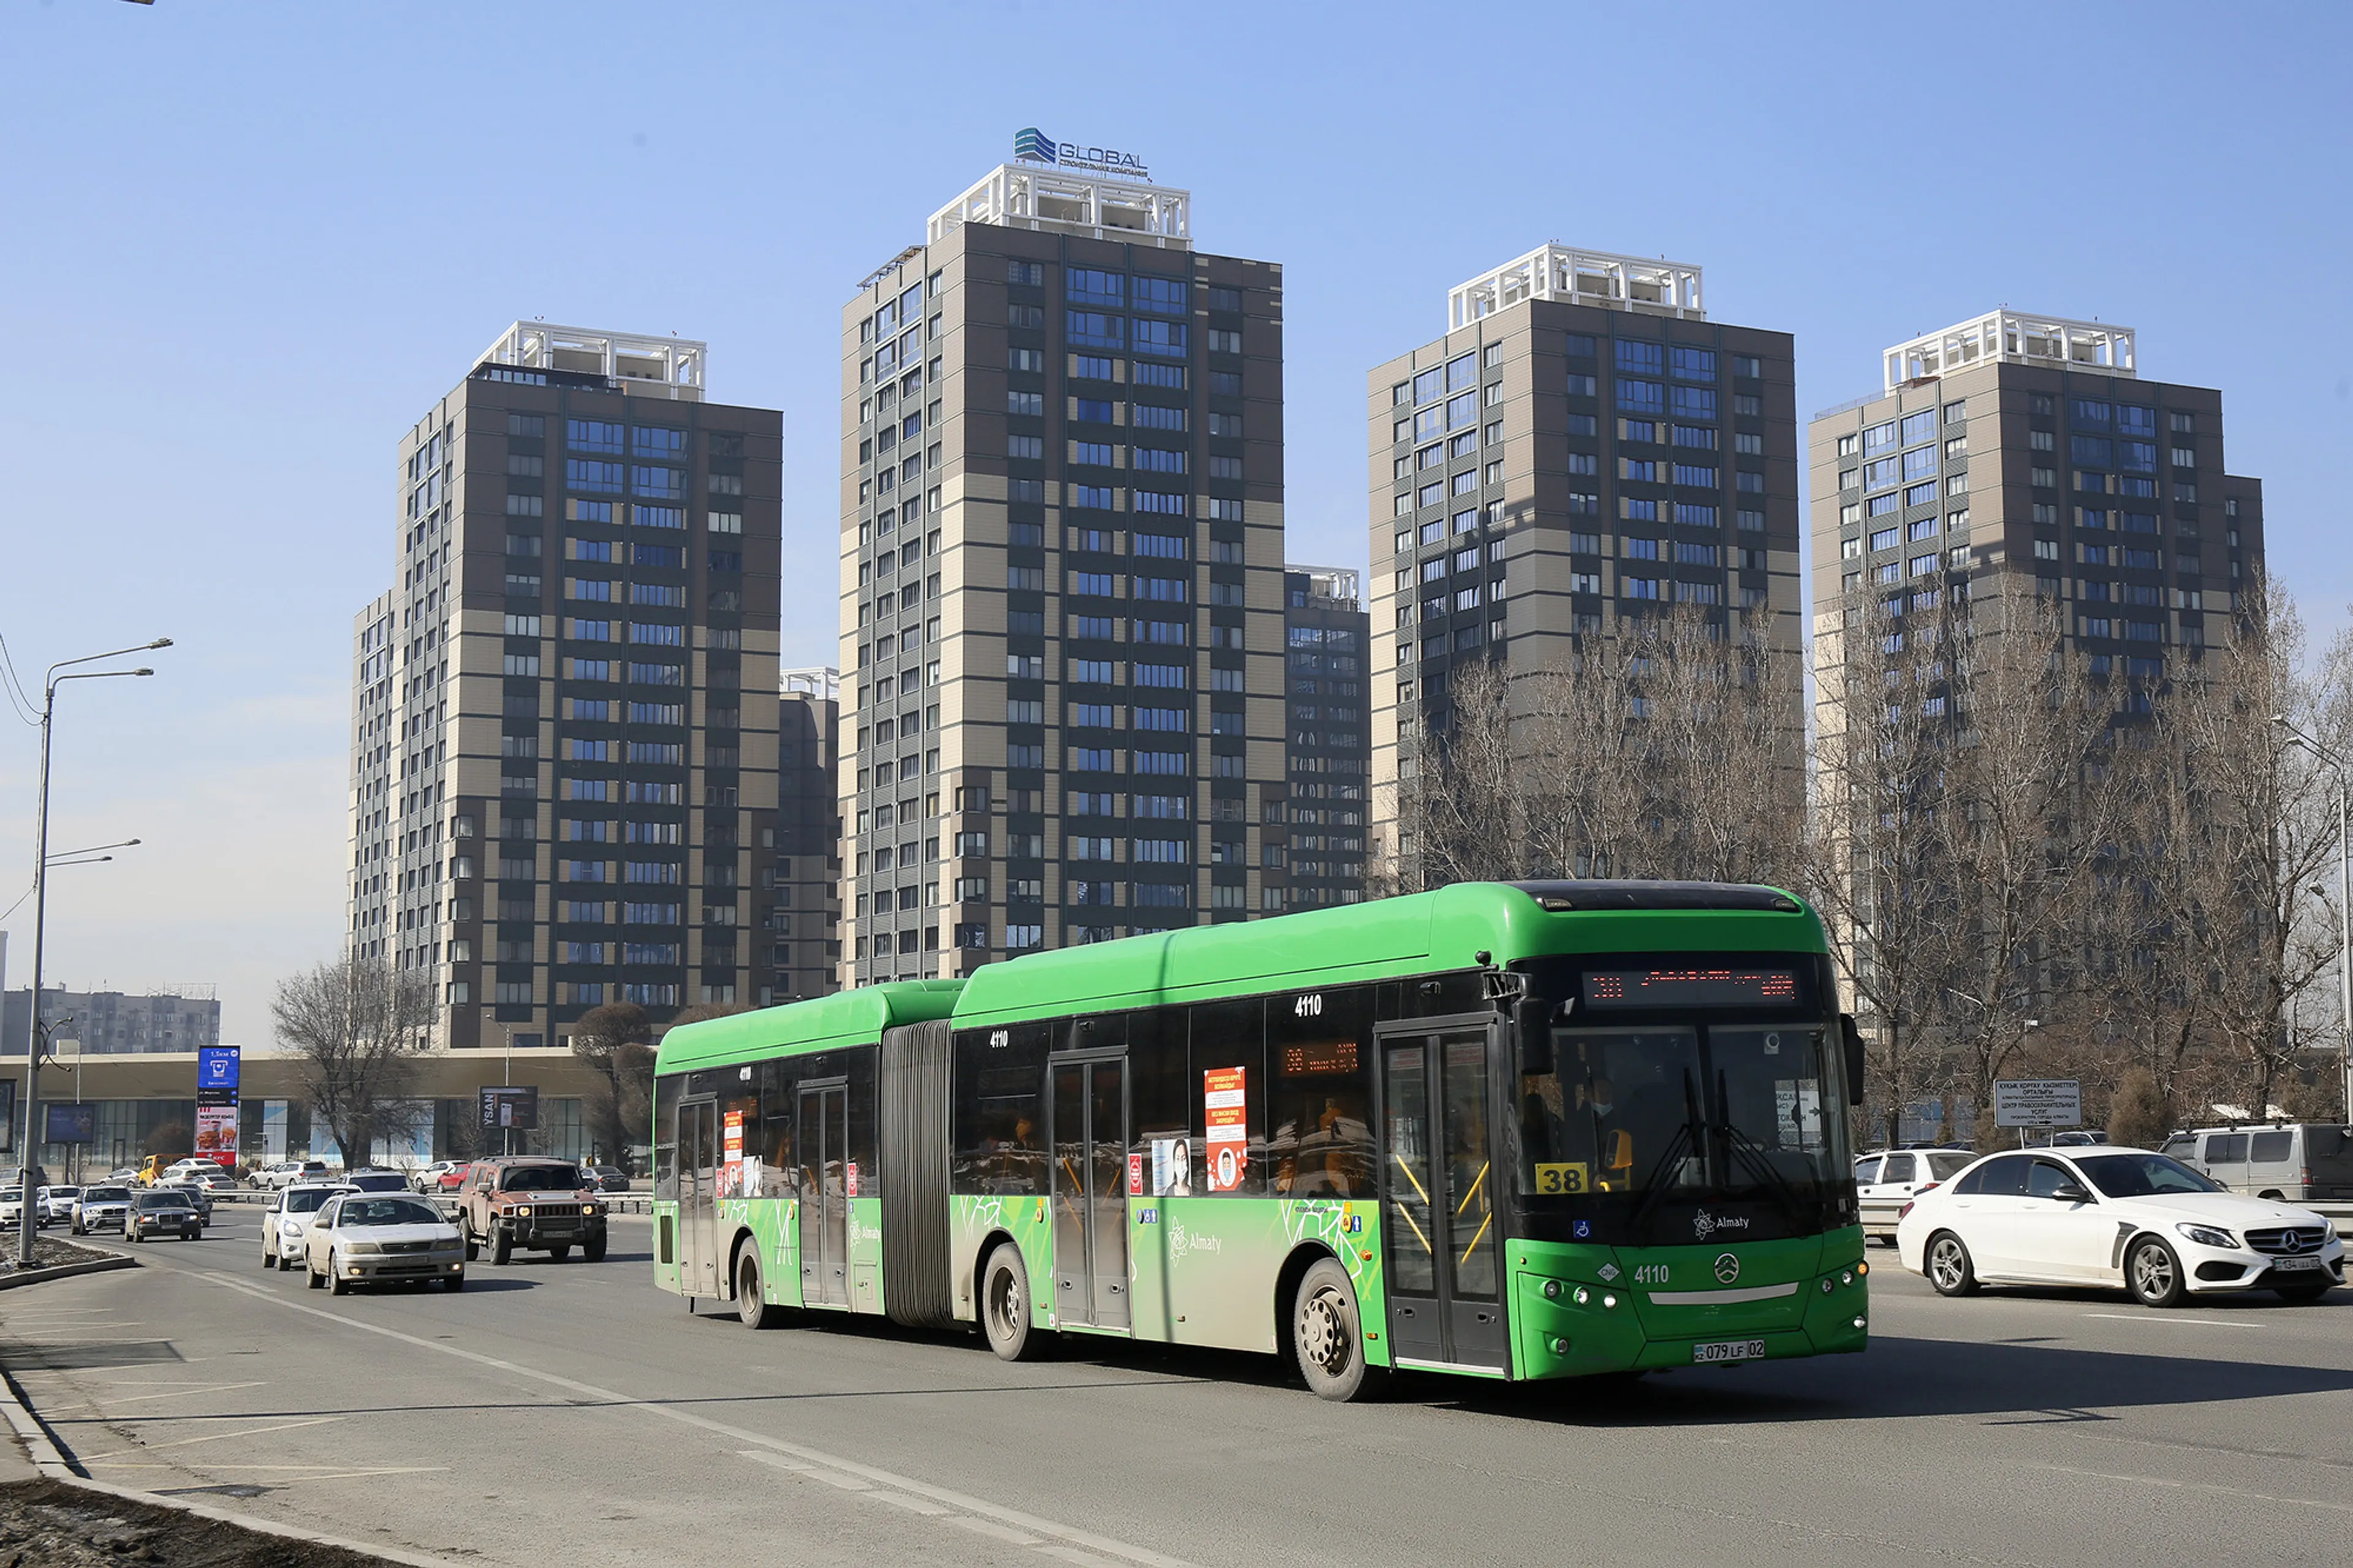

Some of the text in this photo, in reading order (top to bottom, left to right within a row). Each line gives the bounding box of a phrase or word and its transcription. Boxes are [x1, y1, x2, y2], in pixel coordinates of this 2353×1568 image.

[1059, 142, 1148, 169] GLOBAL
[1295, 994, 1322, 1017] 4110
[990, 1029, 1008, 1048] 4110
[739, 1066, 751, 1081] 4110
[1544, 1169, 1582, 1193] 38
[1716, 1216, 1749, 1229] Almaty
[1189, 1232, 1222, 1256] Almaty
[1634, 1265, 1669, 1284] 4110
[1707, 1344, 1728, 1359] 079
[1731, 1346, 1743, 1357] LF
[1749, 1342, 1764, 1356] 02
